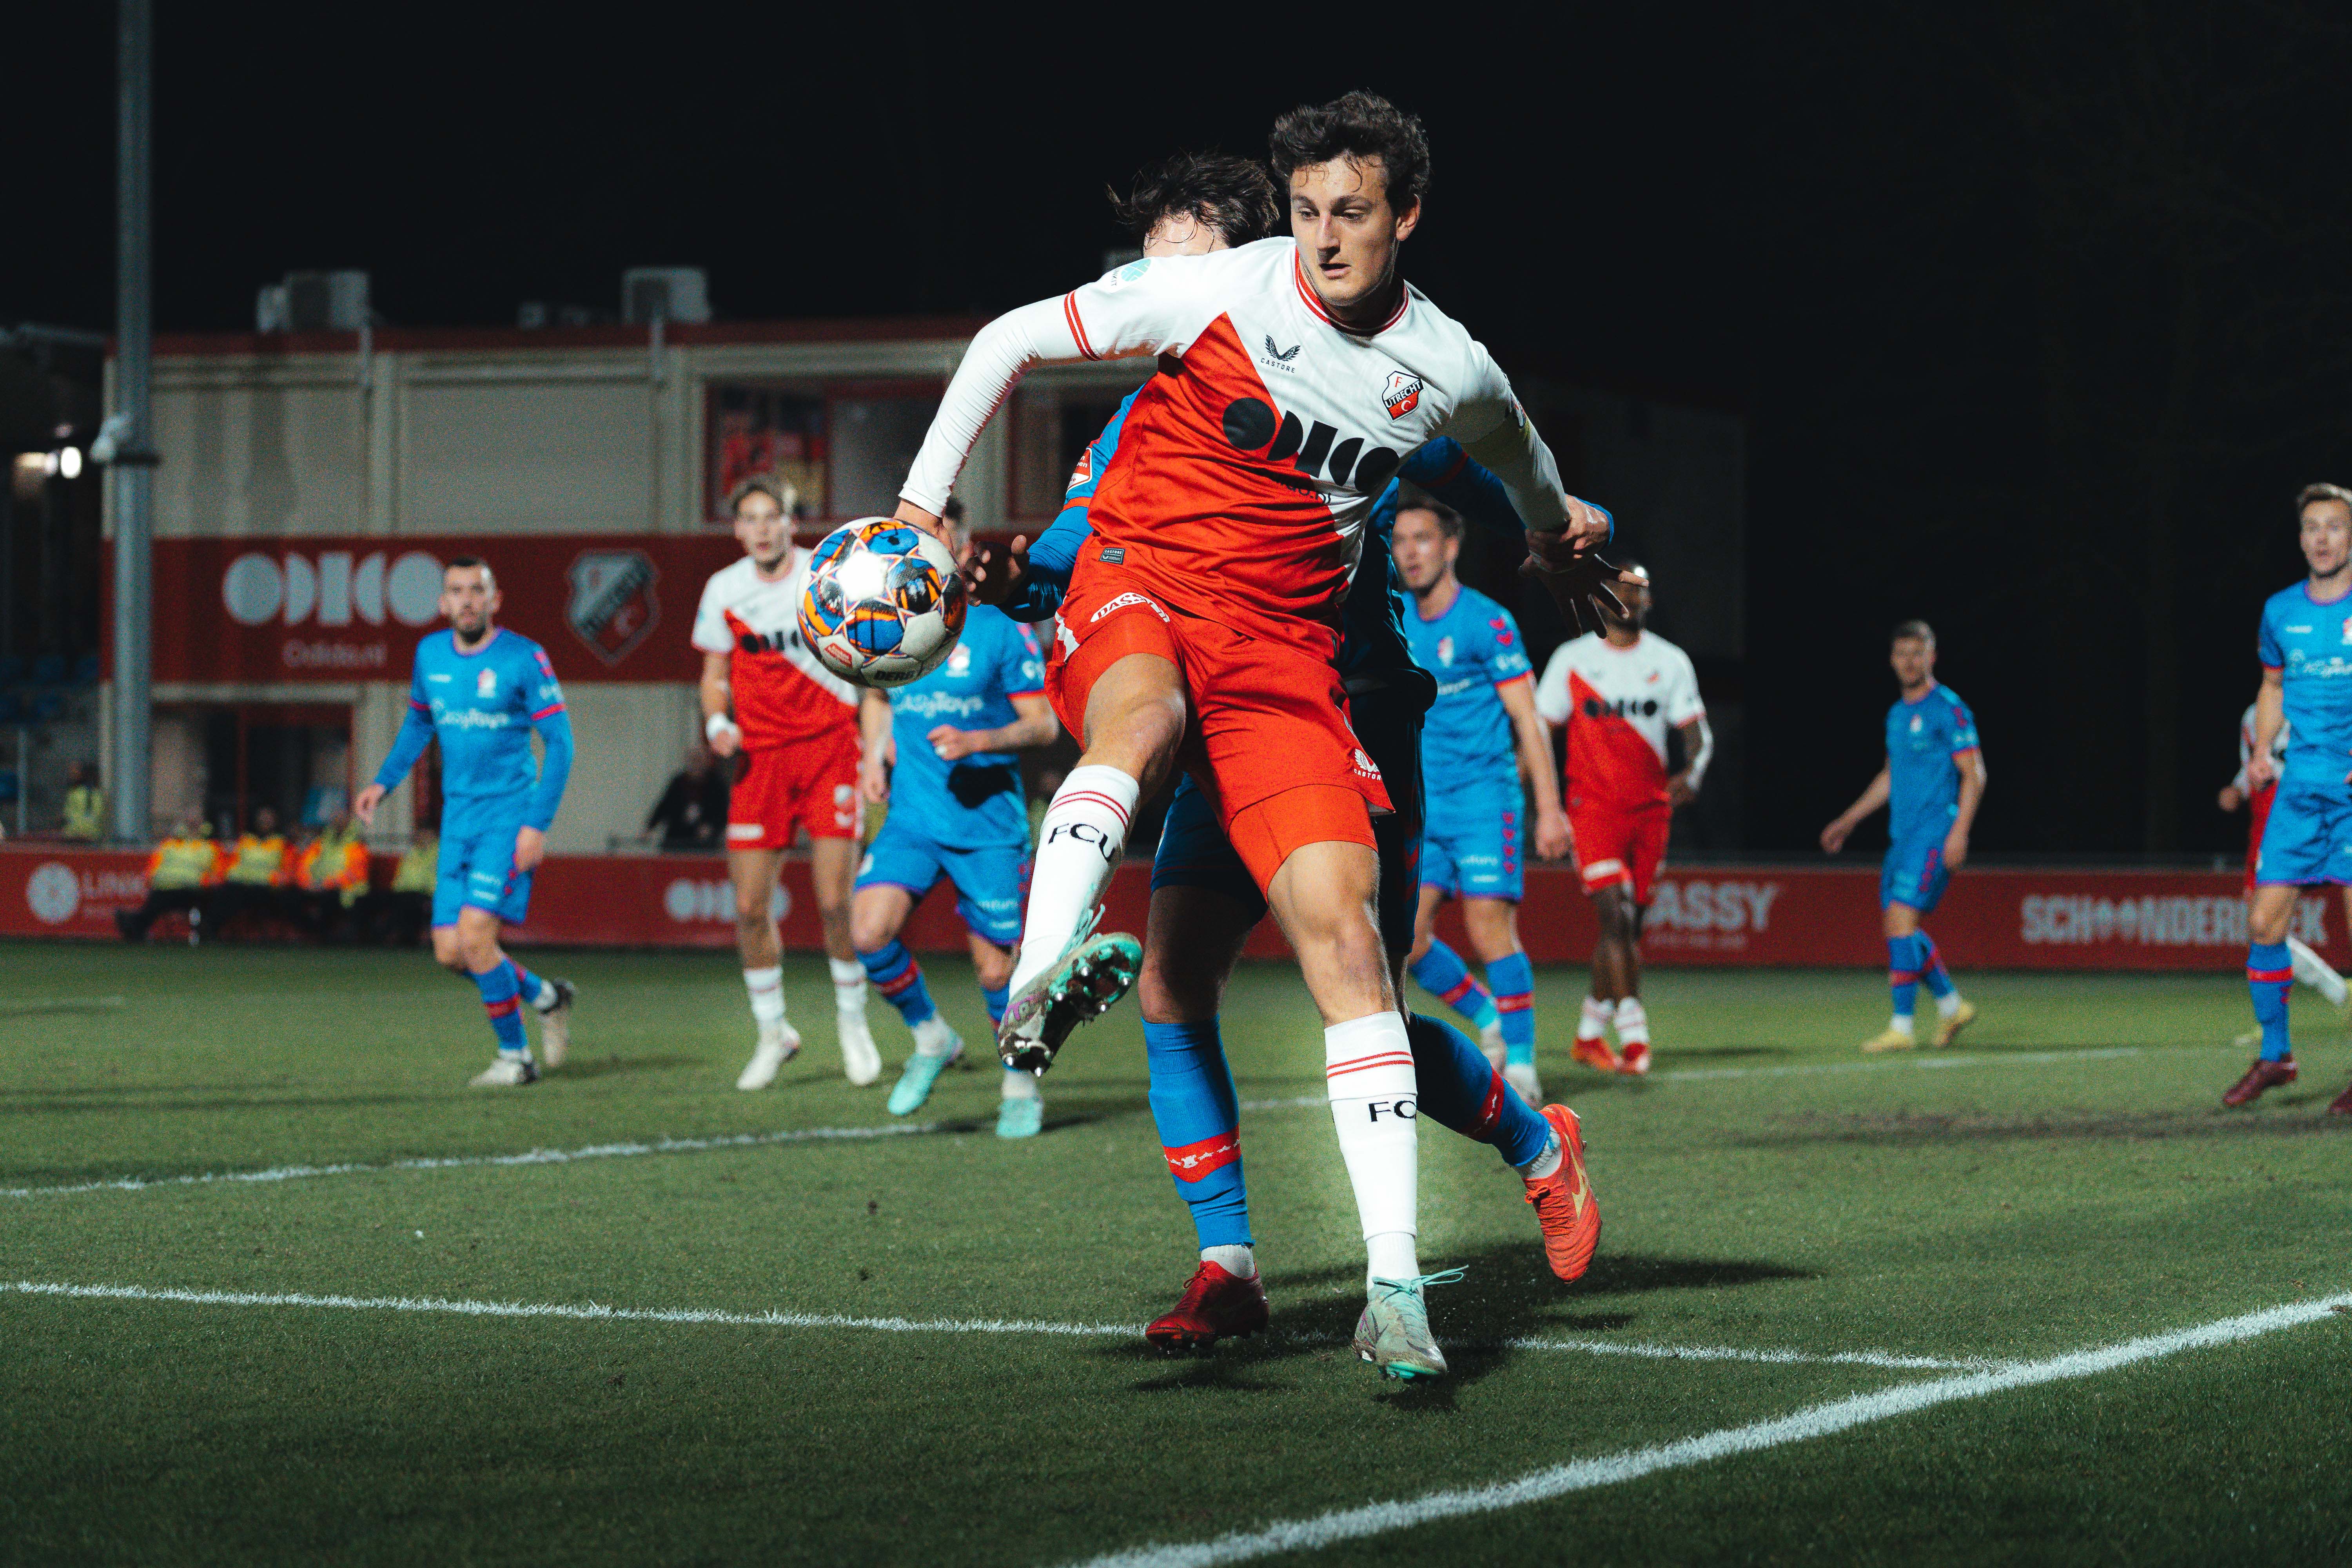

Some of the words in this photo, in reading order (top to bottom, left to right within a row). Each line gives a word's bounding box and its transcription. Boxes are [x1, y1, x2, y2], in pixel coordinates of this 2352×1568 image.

[1260, 358, 1295, 373] CASTORE
[1394, 376, 1403, 388] F
[1384, 381, 1421, 408] UTRECHT
[1401, 399, 1412, 412] C
[1354, 768, 1382, 781] CASTOR
[1048, 823, 1116, 862] FCU
[1642, 880, 1778, 933] ASSY
